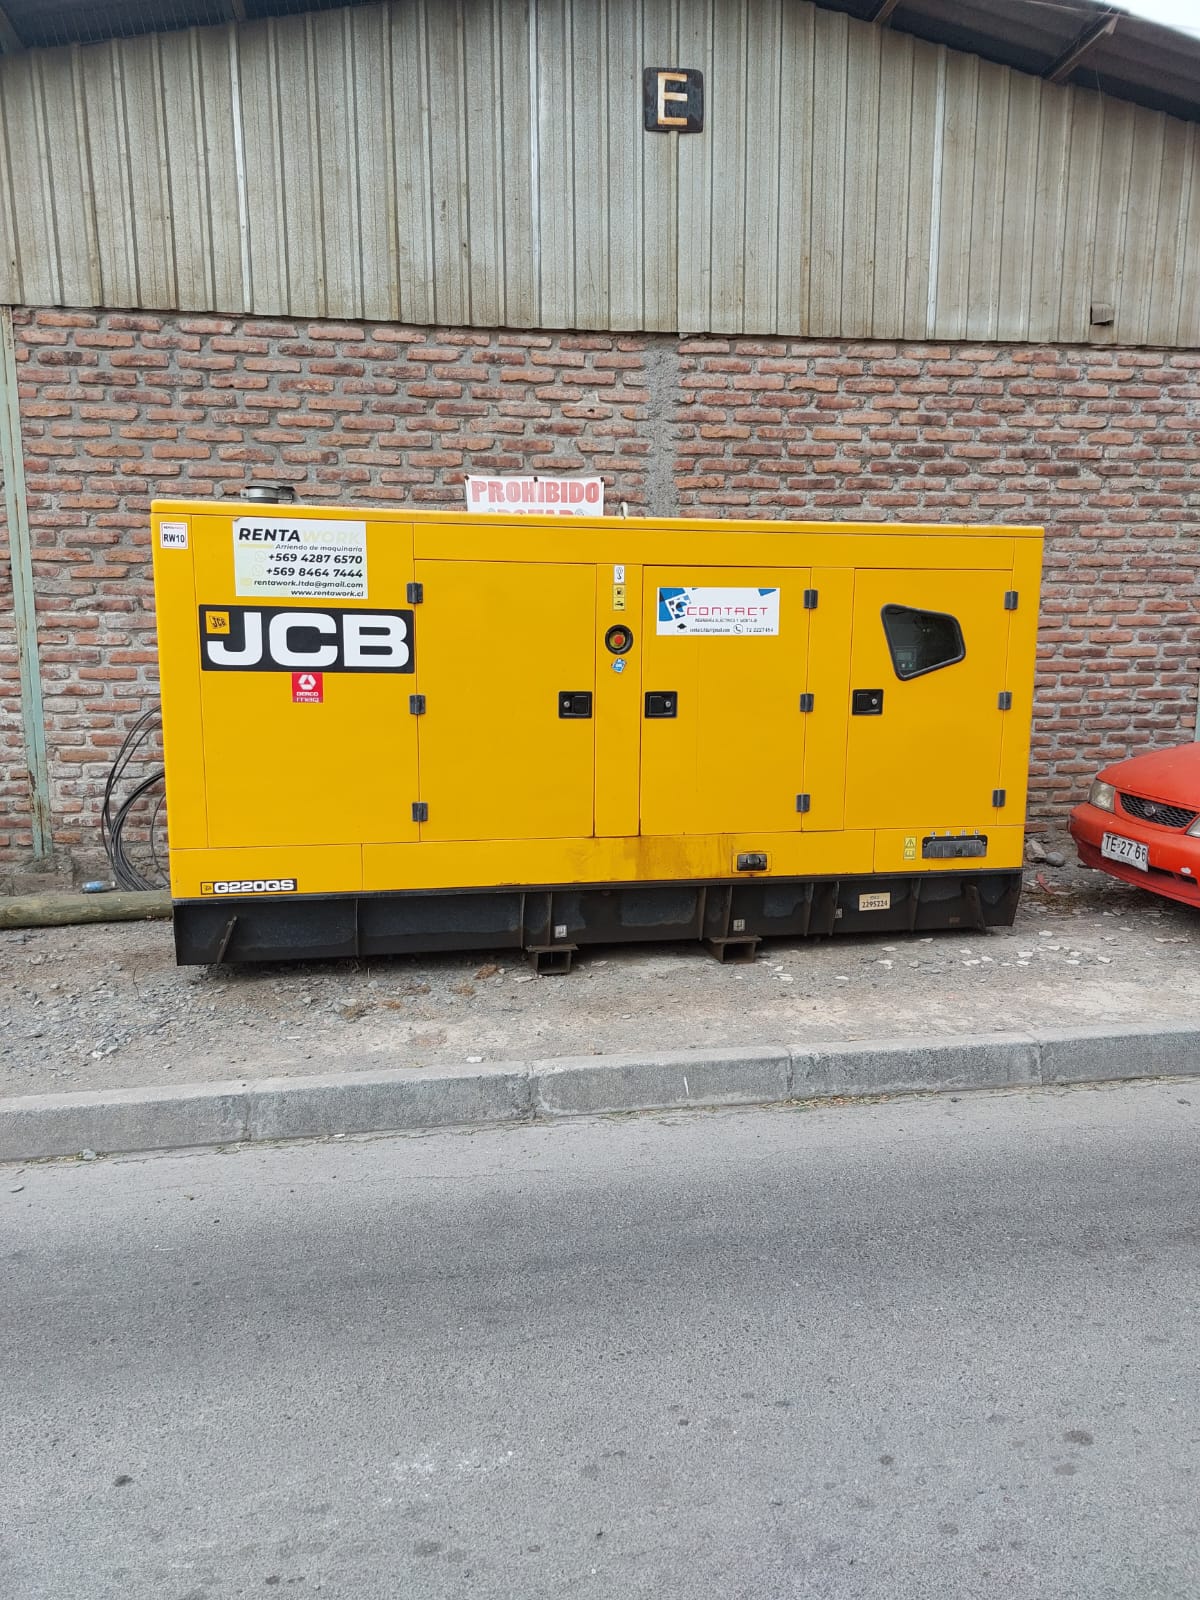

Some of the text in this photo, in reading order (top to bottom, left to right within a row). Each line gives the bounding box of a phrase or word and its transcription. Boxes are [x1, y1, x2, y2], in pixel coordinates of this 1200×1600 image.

[657, 71, 688, 126] E
[471, 480, 600, 503] PROHIBIDO
[163, 533, 185, 543] RW10
[275, 543, 308, 551] Arriendo
[268, 553, 364, 564] +569 4287 6570
[266, 567, 364, 578] +569 8464 7444
[254, 579, 364, 589] rentawork.ltda@gmail.com
[291, 589, 364, 598] www.rentawork.cl
[686, 606, 769, 616] CONTACT
[207, 611, 410, 667] JCB
[214, 879, 294, 893] G220QS
